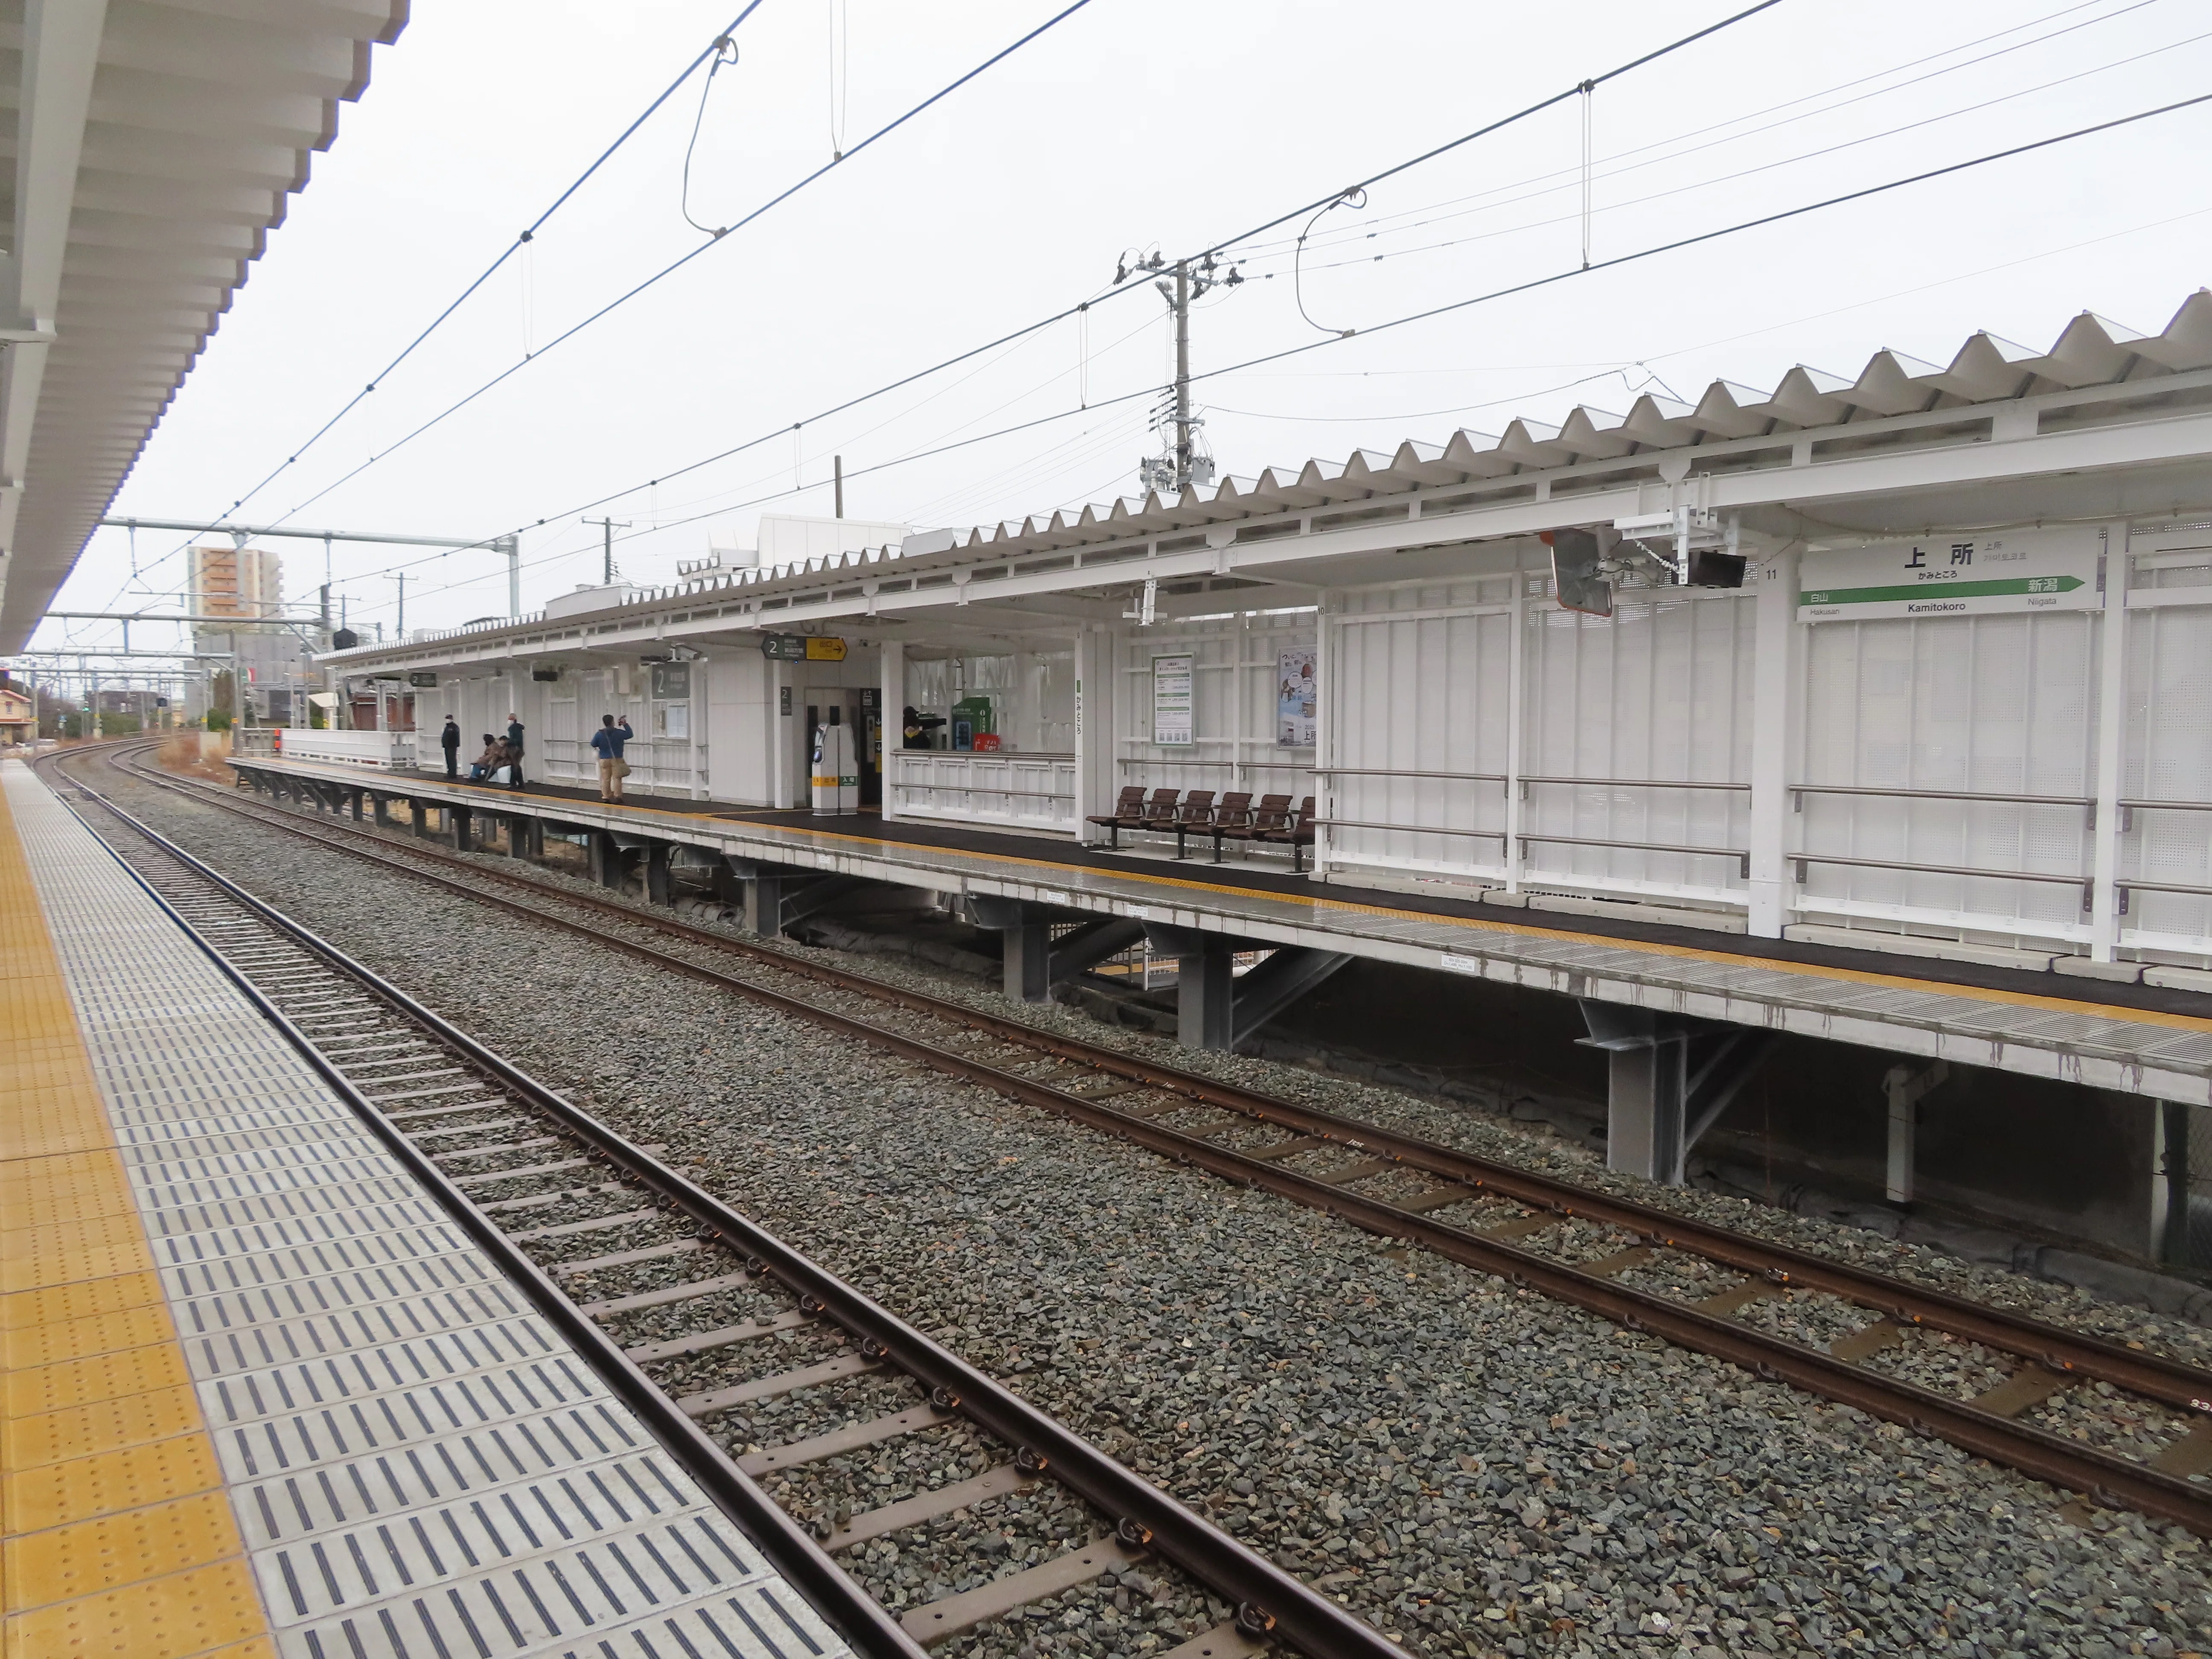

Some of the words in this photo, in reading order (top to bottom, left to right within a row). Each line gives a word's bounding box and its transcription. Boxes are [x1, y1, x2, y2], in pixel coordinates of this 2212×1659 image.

[1984, 541, 2002, 550] 上所
[1904, 542, 1974, 569] 上所
[1766, 569, 1776, 580] 11
[1918, 570, 1958, 580] かみところ
[2028, 578, 2058, 592] 新潟
[1810, 593, 1828, 603] 白山
[2028, 597, 2057, 607] Niigata
[1318, 607, 1325, 616] 10
[1908, 602, 1966, 612] Kamitokoro
[769, 641, 777, 654] 2
[658, 669, 664, 693] 2
[782, 689, 787, 699] 2
